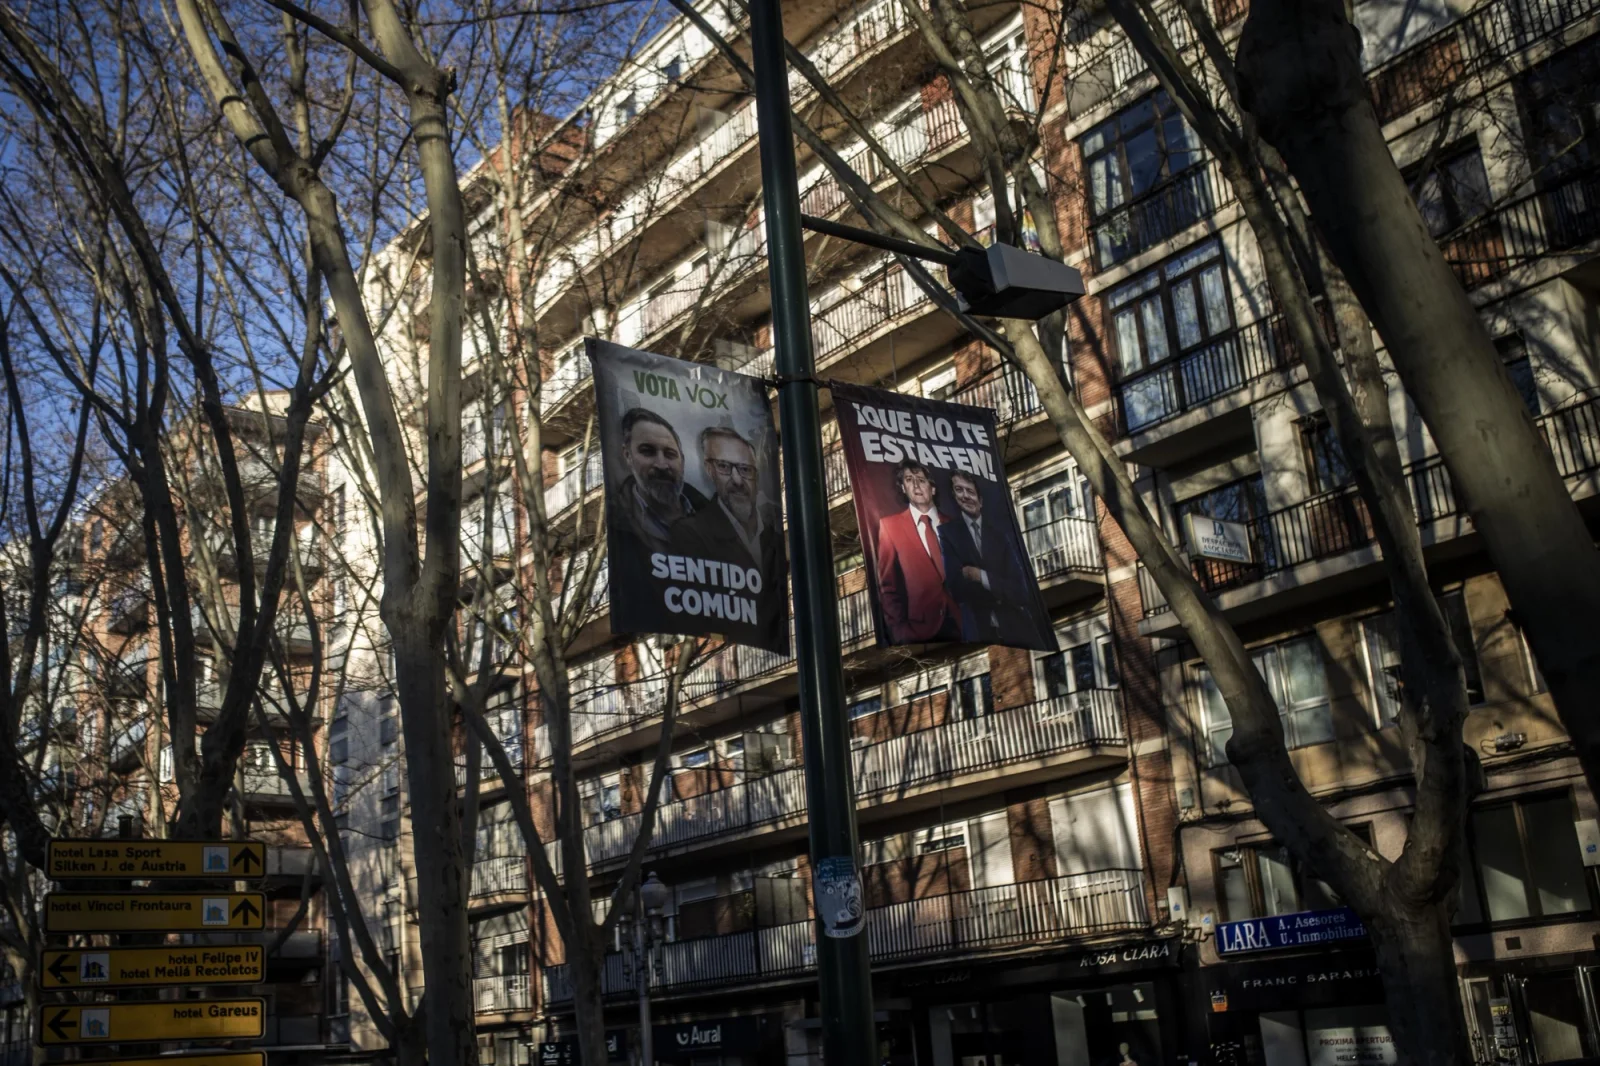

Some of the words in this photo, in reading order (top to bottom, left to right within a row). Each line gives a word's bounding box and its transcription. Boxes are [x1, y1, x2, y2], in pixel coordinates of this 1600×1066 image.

[633, 370, 681, 401] VOTA
[686, 383, 729, 411] VOX
[852, 402, 913, 437] ¡QUE
[916, 414, 953, 442] NO
[956, 420, 990, 447] TE
[860, 432, 997, 483] ESTAFEN!
[650, 553, 762, 594] SENTIDO
[664, 587, 758, 626] COMÚN
[54, 847, 84, 858] hotel
[89, 846, 119, 858] Lasa
[126, 846, 162, 861] Sport
[54, 860, 96, 872] Silken
[101, 861, 113, 872] J.
[119, 860, 134, 872] de
[142, 860, 187, 872] Austria
[51, 901, 82, 912] hotel
[87, 900, 125, 912] Vincci
[130, 899, 192, 911] Frontaura
[1220, 921, 1272, 952] LARA
[1278, 919, 1291, 931] A.
[1294, 912, 1346, 929] Asesores
[1280, 932, 1293, 945] U.
[168, 953, 198, 965] hotel
[202, 951, 242, 968] Felipe
[245, 951, 259, 963] IV
[1080, 950, 1117, 967] ROSA
[120, 967, 150, 979] hotel
[154, 964, 191, 978] Meliá
[195, 964, 259, 977] Recoletos
[1243, 975, 1297, 989] FRANC
[173, 1008, 203, 1019] hotel
[208, 1004, 258, 1018] Gareus
[690, 1024, 722, 1045] Aural
